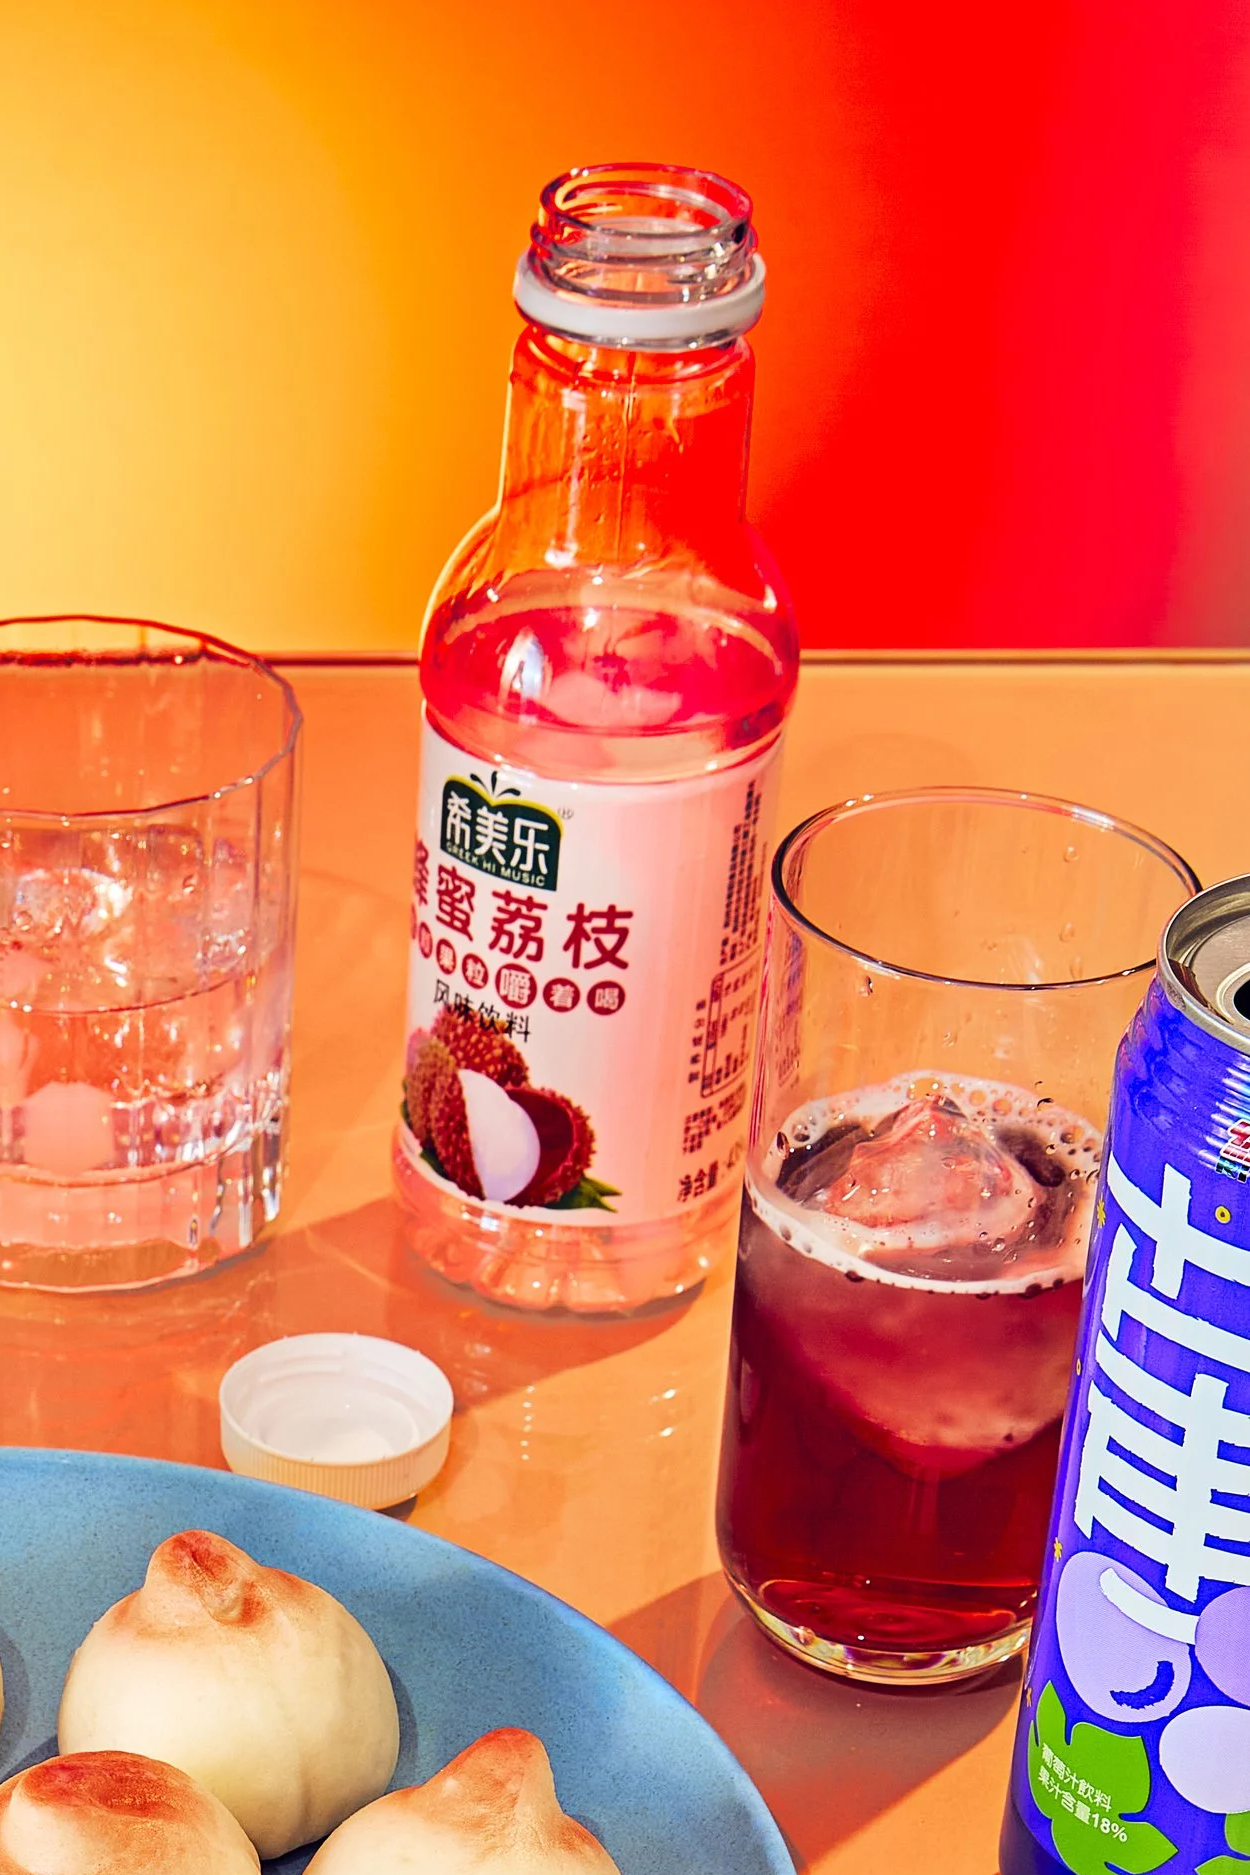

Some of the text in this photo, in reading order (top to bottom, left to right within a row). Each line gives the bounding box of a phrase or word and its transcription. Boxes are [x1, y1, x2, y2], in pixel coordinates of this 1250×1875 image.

[447, 790, 550, 875] 希美乐
[483, 859, 496, 873] HI
[500, 865, 546, 888] MUSIC
[414, 912, 622, 1011] 果粒嚼着喝
[433, 978, 532, 1044] 风味饮料
[1037, 1764, 1129, 1844] 果汁含量18%
[1040, 1742, 1112, 1813] 葡萄汁飲料
